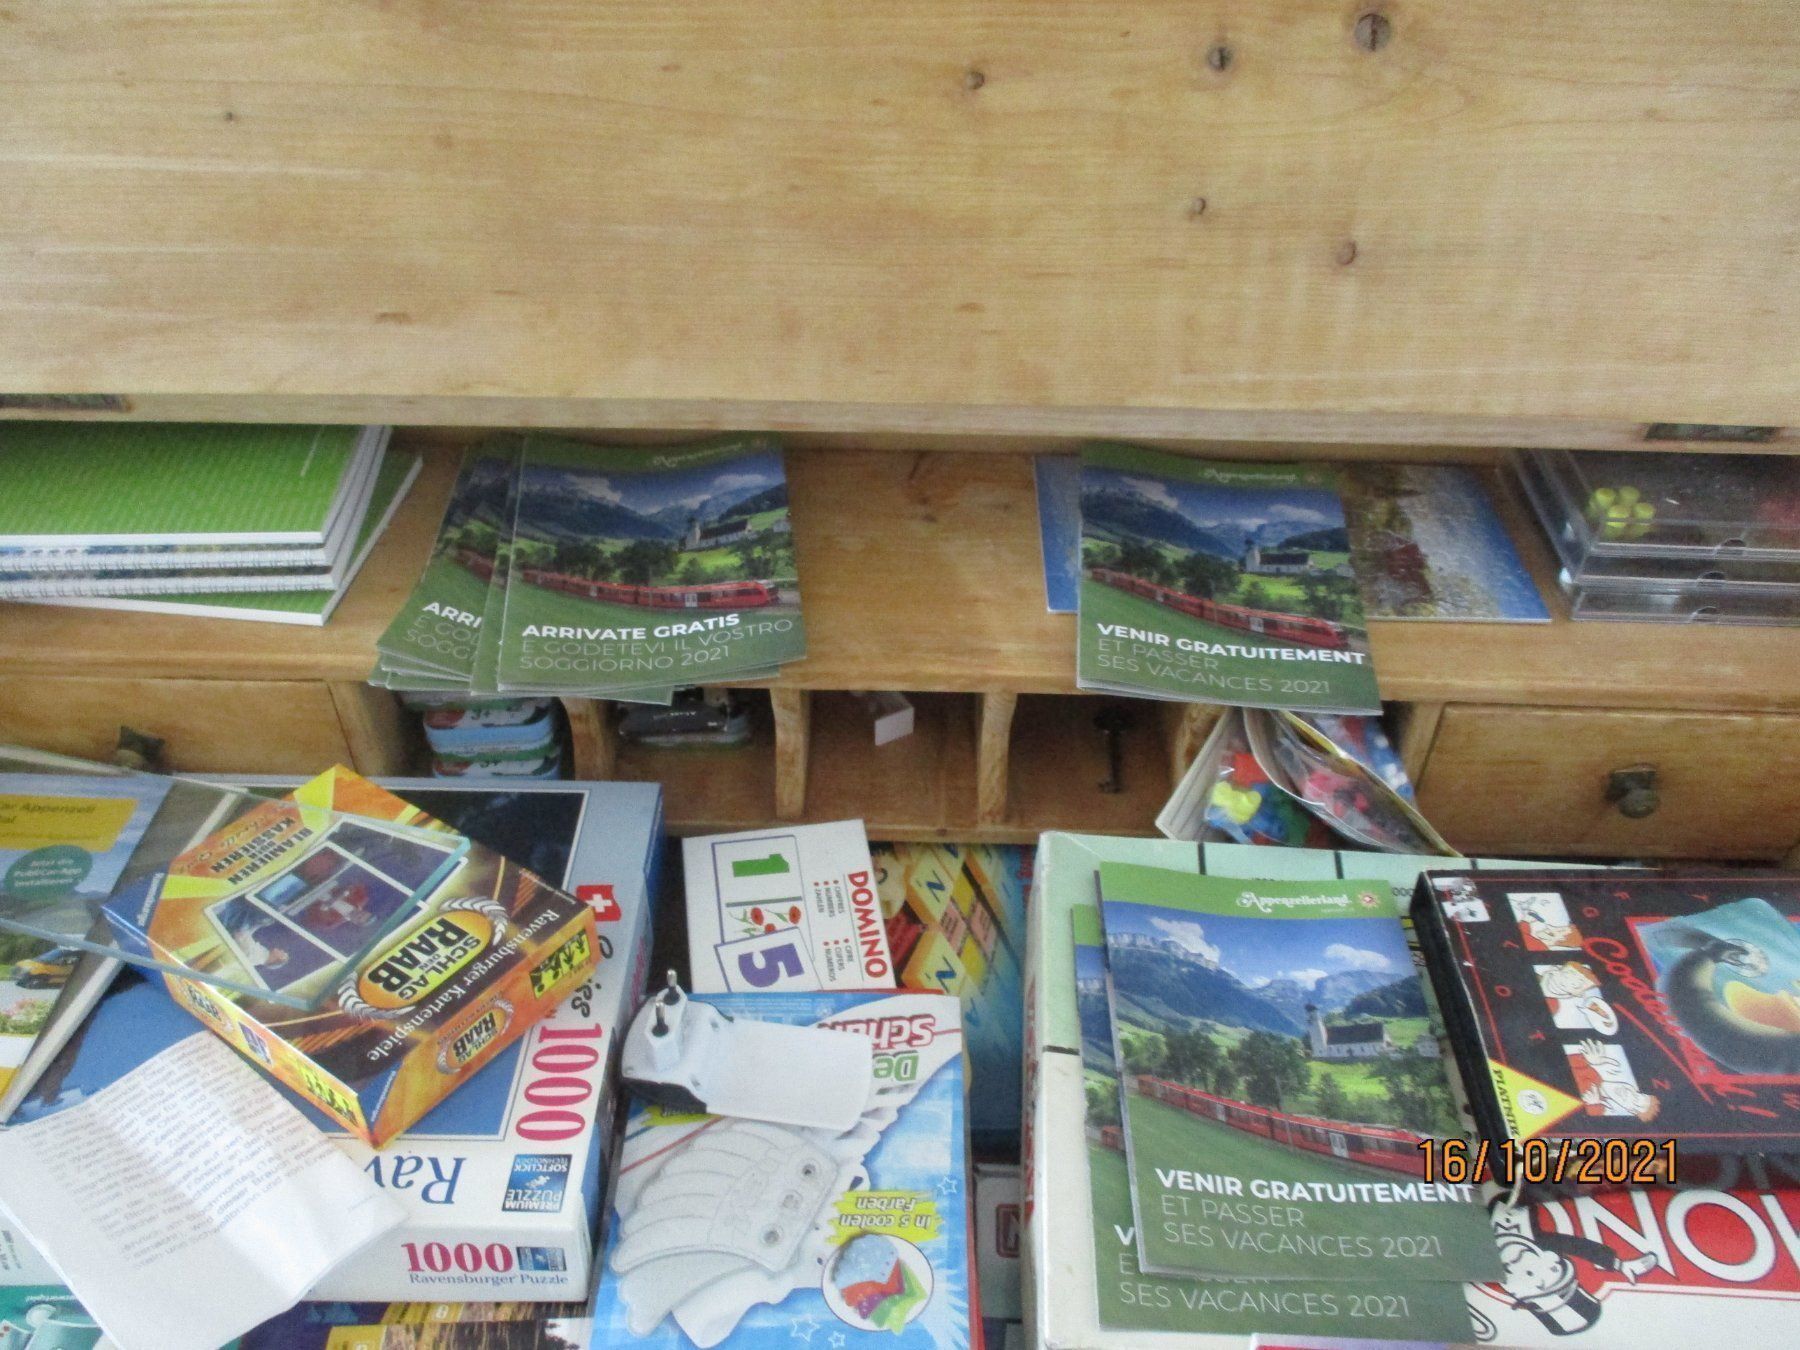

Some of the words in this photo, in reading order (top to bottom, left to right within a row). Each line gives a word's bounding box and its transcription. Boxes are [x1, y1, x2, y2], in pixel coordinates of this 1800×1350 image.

[522, 623, 647, 640] ARRIVATE
[653, 613, 741, 638] GRATIS
[523, 640, 534, 654] E
[538, 640, 666, 657] GODETEVI
[674, 638, 692, 653] IL
[700, 617, 794, 647] VOSTRO
[1097, 623, 1169, 647] VENIR
[1176, 637, 1366, 665] GRATUITEMENT
[519, 655, 674, 672] SOGGIORNO
[681, 645, 730, 667] 2021
[1099, 639, 1125, 653] ET
[1132, 641, 1219, 670] PASSER
[1098, 655, 1140, 673] SES
[1146, 662, 1272, 692] VACANCES
[1280, 679, 1330, 693] 2021
[210, 815, 296, 874] KASSIEREN
[732, 853, 790, 878] 1
[848, 870, 888, 979] DOMINO
[368, 917, 470, 993] RAAB
[463, 909, 560, 986] Ravensburger
[738, 943, 805, 988] 5
[398, 935, 481, 1000] SCHLAG
[367, 984, 467, 1062] Kartenspiele
[515, 1022, 603, 1141] 1000
[363, 1155, 467, 1206] Rav
[507, 1189, 563, 1201] PUZZLE
[1155, 1168, 1244, 1197] VENIR
[1250, 1179, 1475, 1204] GRATUITEMENT
[504, 1200, 560, 1211] PREMIUM
[839, 1214, 895, 1228] coolen
[855, 1196, 916, 1212] Farben
[1162, 1195, 1192, 1217] ET
[1203, 1199, 1305, 1228] PASSER
[401, 1242, 514, 1274] 1000
[1164, 1222, 1214, 1247] SES
[1221, 1228, 1373, 1258] VACANCES
[1381, 1236, 1442, 1258] 2021
[409, 1274, 516, 1288] Ravensburger
[520, 1272, 569, 1286] Puzzle
[1119, 1282, 1171, 1308] SES
[1179, 1287, 1338, 1315] VACANCES
[1350, 1295, 1409, 1318] 2021
